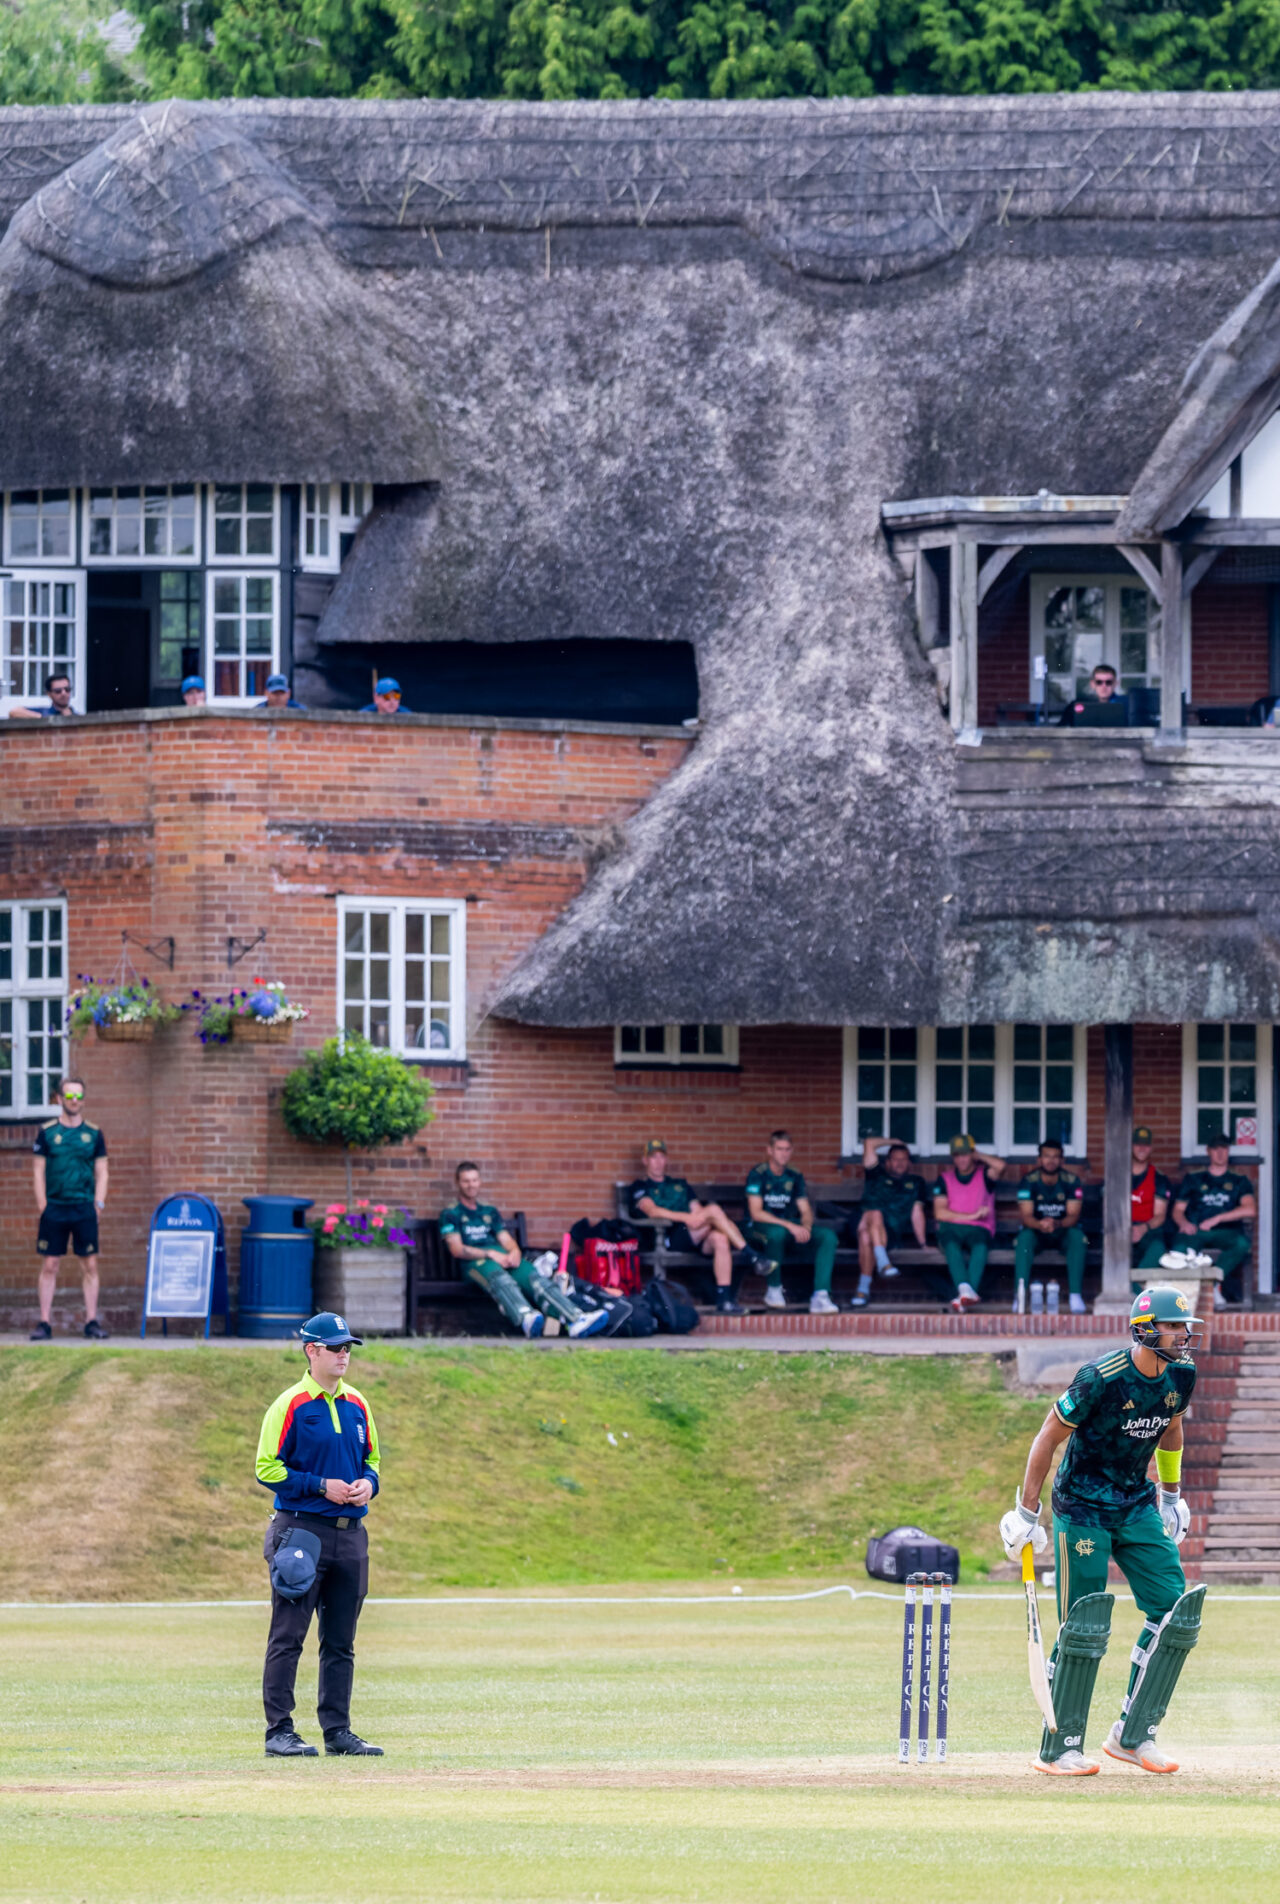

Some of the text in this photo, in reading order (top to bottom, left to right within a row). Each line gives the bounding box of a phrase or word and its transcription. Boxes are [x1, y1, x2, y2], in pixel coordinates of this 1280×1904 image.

[1121, 1416, 1171, 1430] John Pye
[1064, 1736, 1081, 1746] GM
